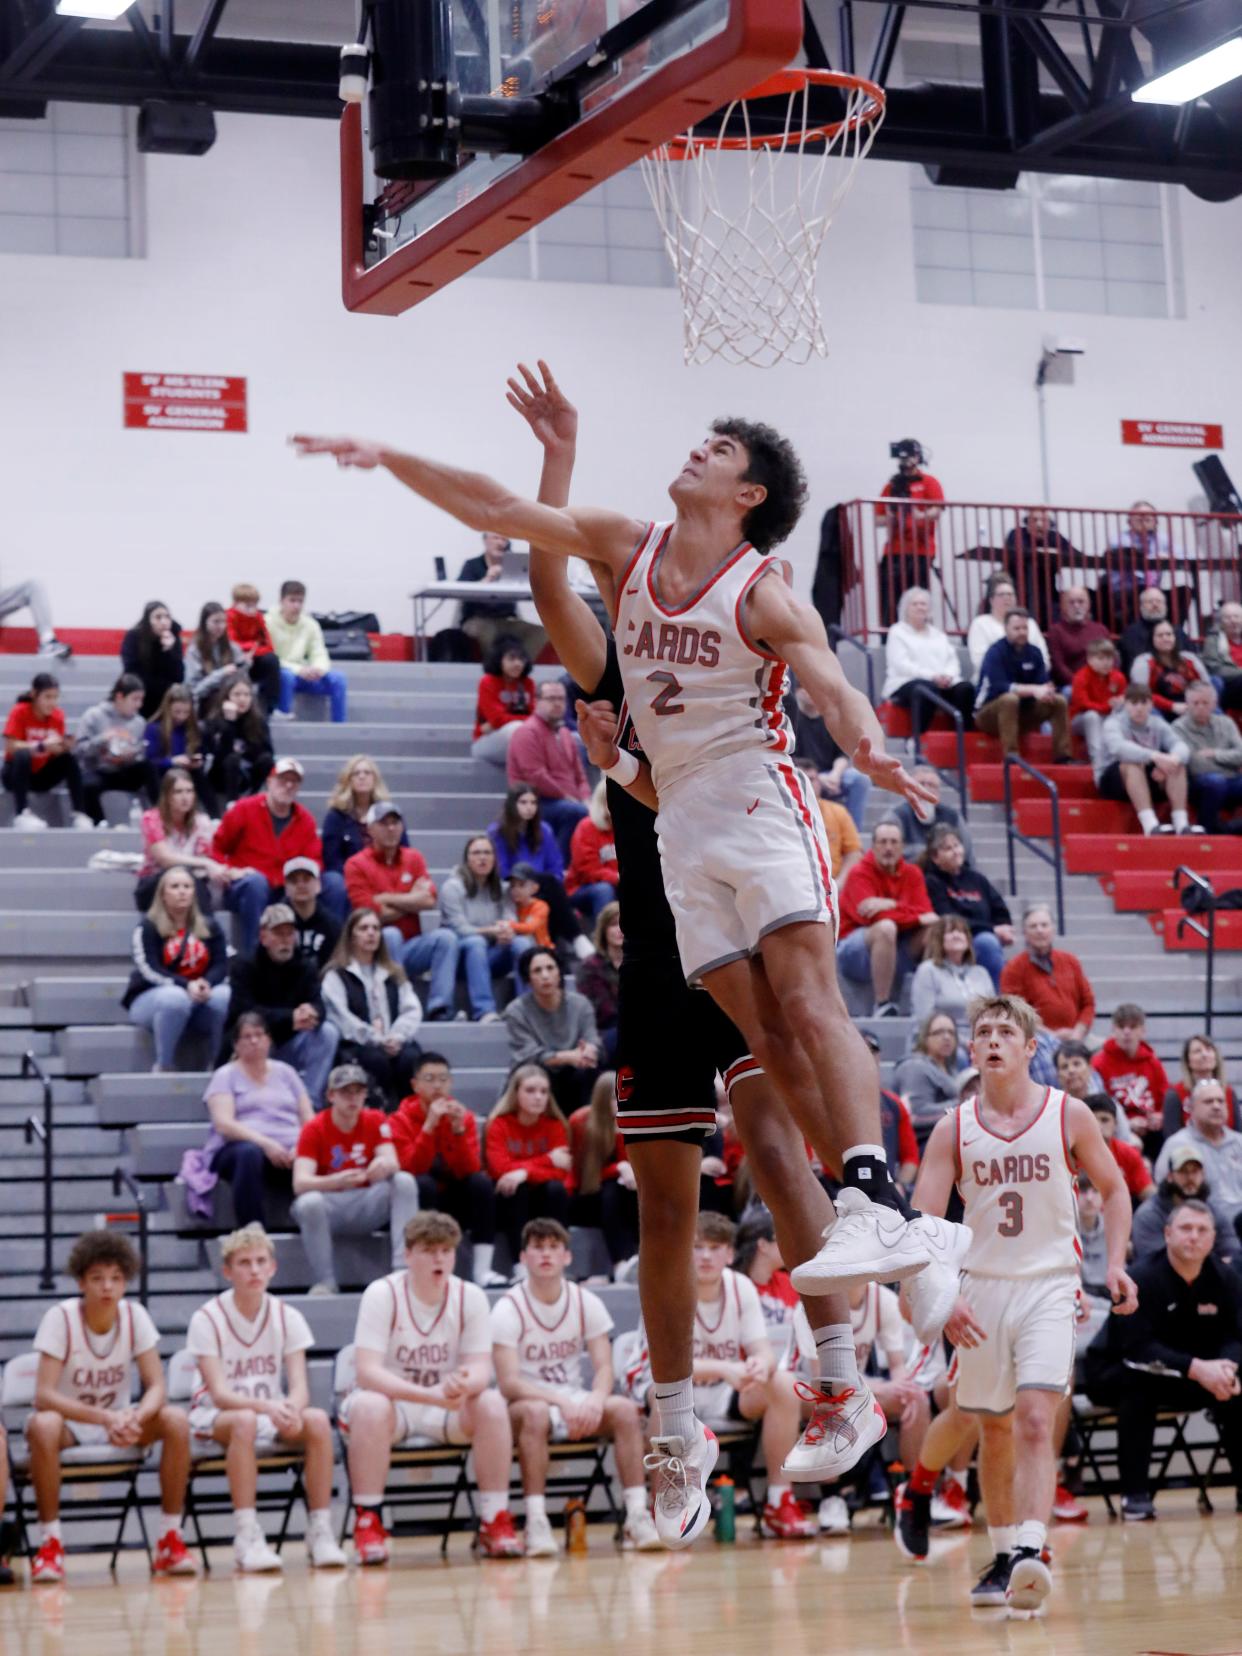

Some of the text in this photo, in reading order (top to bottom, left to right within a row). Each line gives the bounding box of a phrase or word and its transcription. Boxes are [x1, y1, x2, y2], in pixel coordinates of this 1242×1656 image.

[645, 669, 686, 716] 2
[972, 1153, 1050, 1187] CARDS
[998, 1191, 1023, 1237] 3
[395, 1342, 449, 1365] CARDS
[525, 1336, 577, 1361] CARDS
[71, 1364, 125, 1388] CARDS
